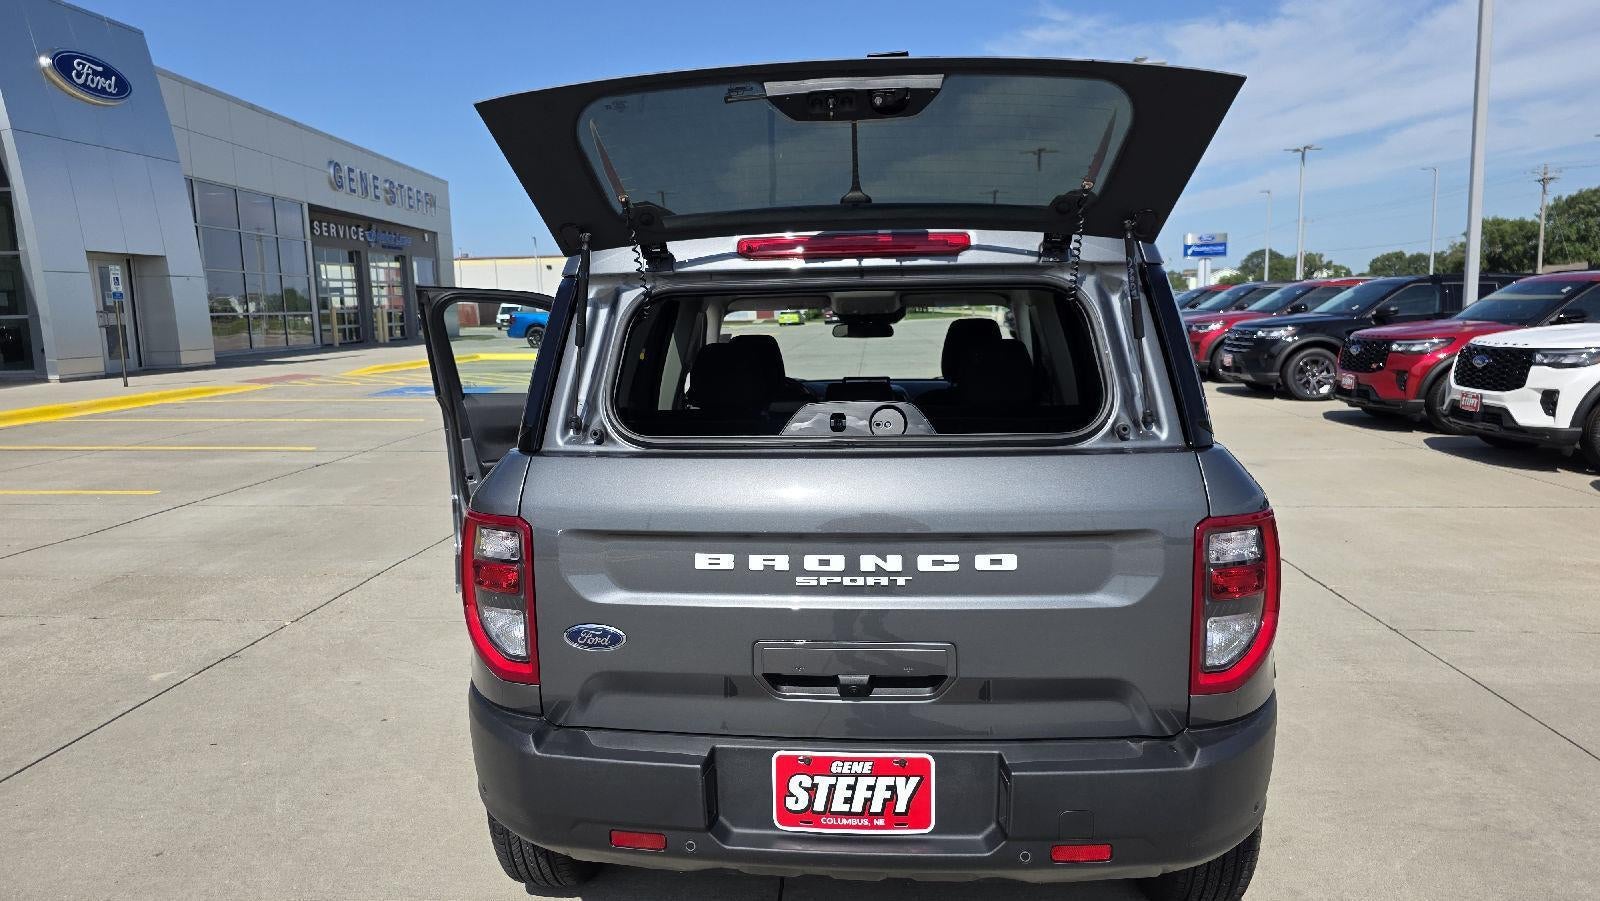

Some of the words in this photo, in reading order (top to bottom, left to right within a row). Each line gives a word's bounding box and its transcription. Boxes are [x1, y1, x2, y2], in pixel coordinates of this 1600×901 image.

[72, 58, 118, 93] Ford
[328, 160, 381, 201] GENE
[313, 220, 365, 241] SERVICE
[694, 552, 1018, 572] BRONCO
[795, 576, 913, 586] SPORT
[578, 629, 611, 646] Ford
[830, 760, 874, 774] GENE
[784, 773, 924, 815] STEFFY
[820, 817, 871, 826] COLUMBUS,
[873, 818, 885, 826] NE
